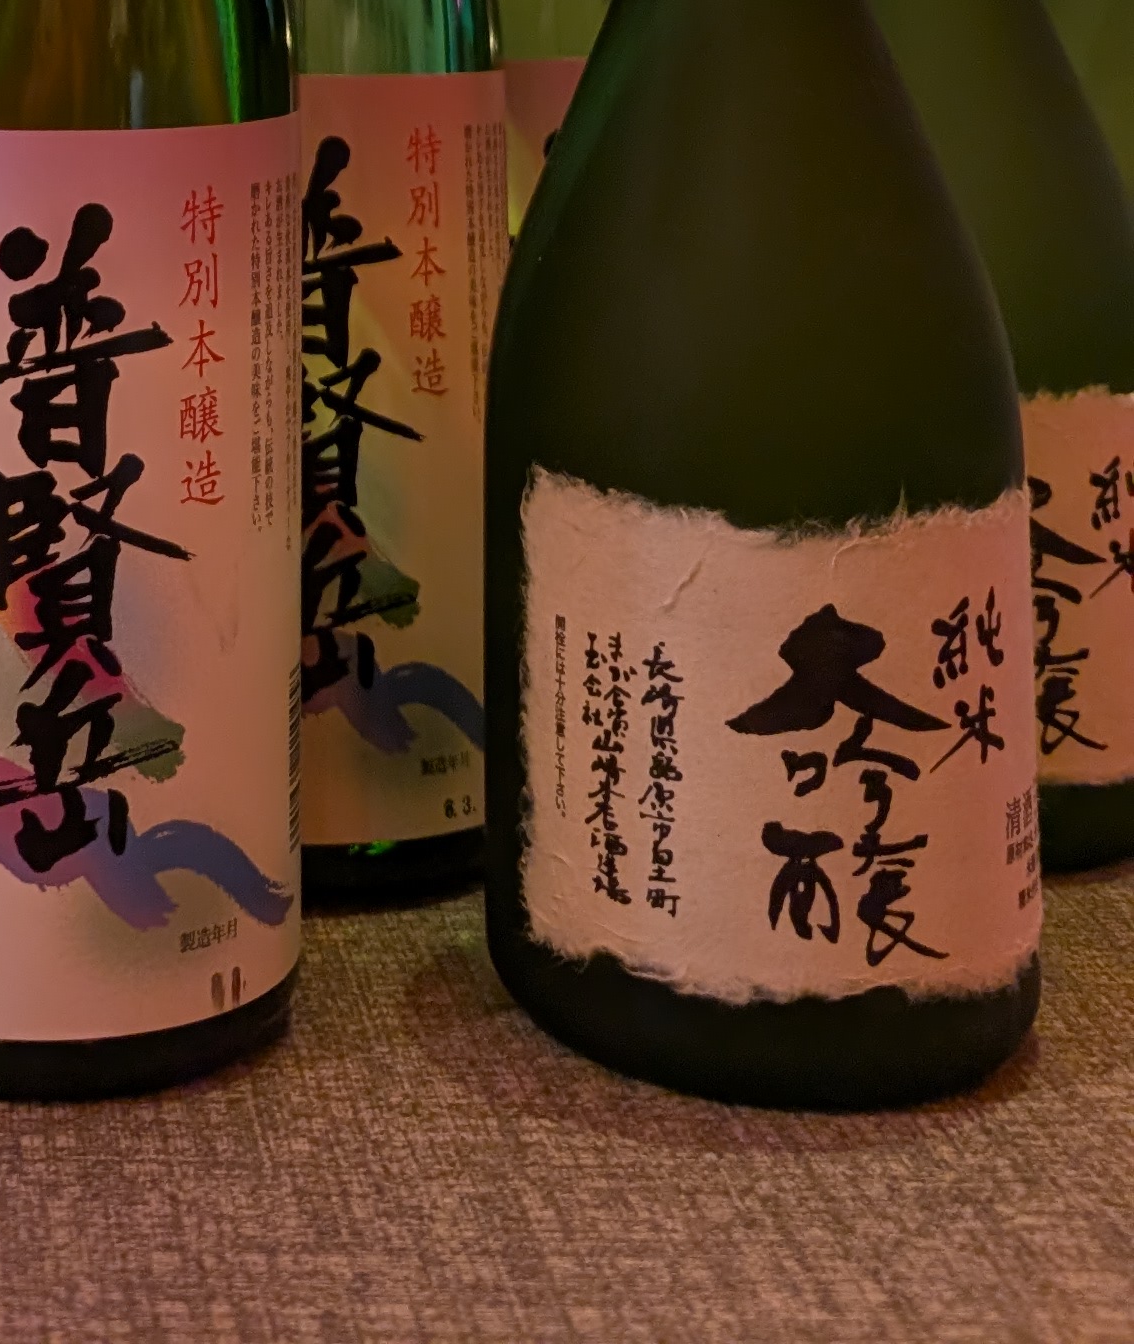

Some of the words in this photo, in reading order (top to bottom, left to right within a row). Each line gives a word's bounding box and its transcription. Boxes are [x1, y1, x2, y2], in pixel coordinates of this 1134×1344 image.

[178, 184, 227, 507] 特別本醸造
[405, 123, 450, 399] 特別本醸造
